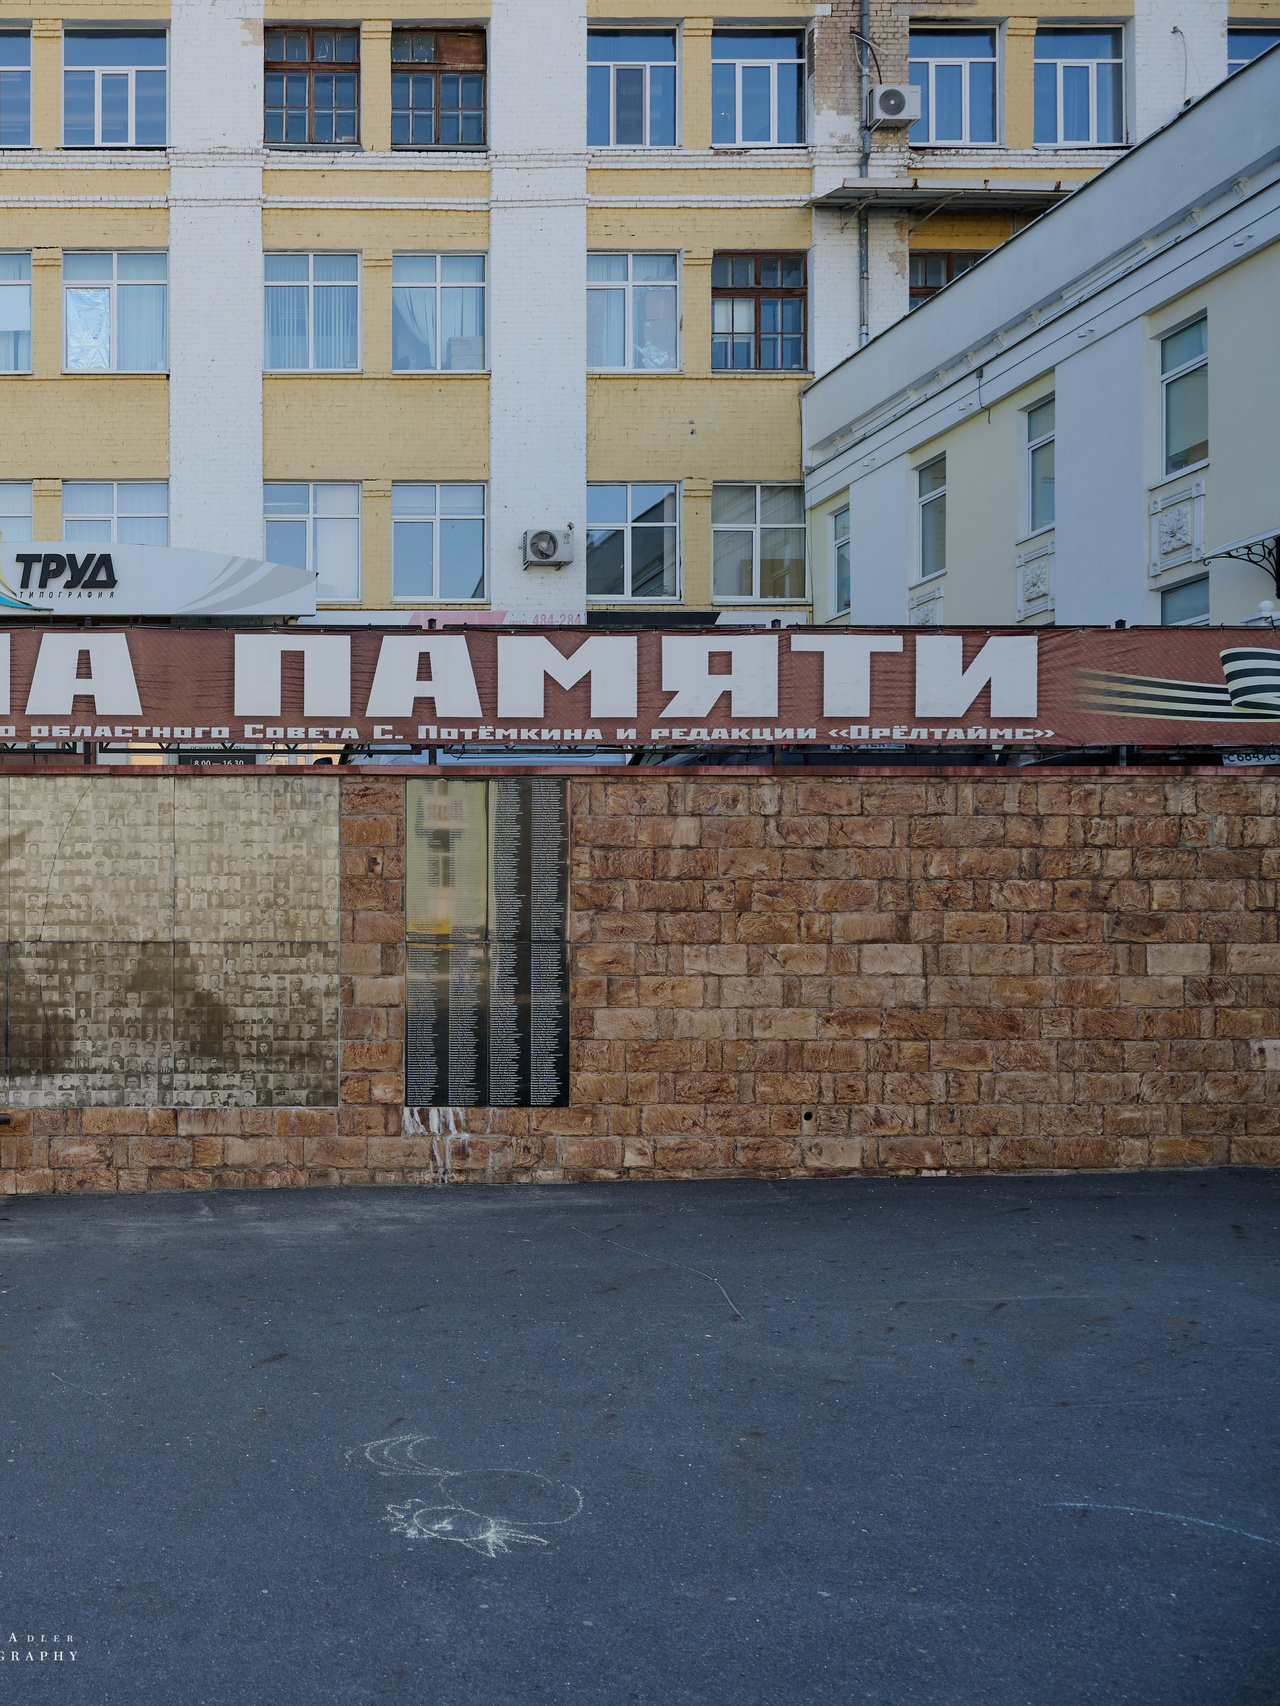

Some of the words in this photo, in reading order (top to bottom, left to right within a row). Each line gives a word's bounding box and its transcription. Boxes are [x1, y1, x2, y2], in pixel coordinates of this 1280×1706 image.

[15, 553, 118, 589] ТРУД
[19, 591, 116, 599] ТИПОГРАФИЯ
[532, 614, 581, 625] 484-284
[233, 634, 1039, 719] ПАМЯТИ
[373, 724, 404, 739] С.
